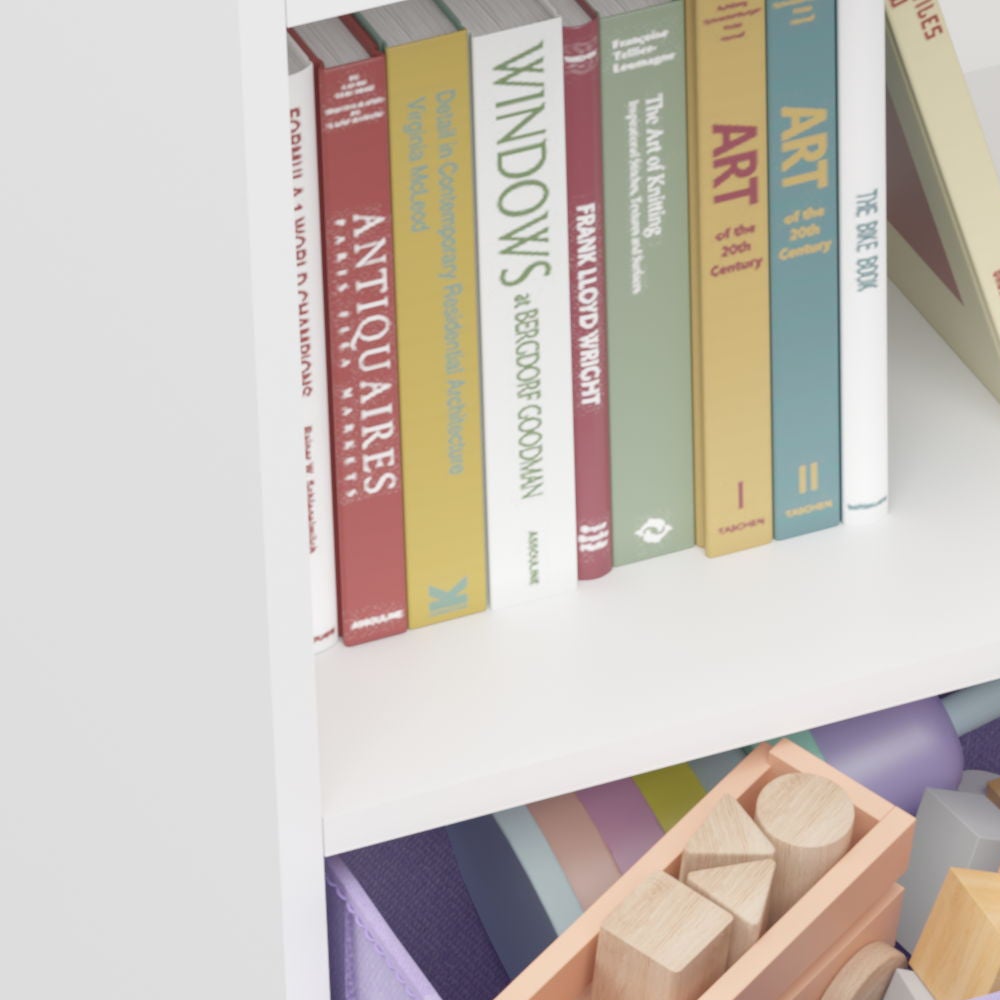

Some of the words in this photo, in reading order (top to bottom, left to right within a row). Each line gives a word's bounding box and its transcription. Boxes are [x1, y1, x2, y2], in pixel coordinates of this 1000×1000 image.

[912, 0, 943, 40] ILES
[434, 89, 456, 146] Detail
[644, 92, 664, 125] The
[404, 96, 427, 165] Virginia
[646, 128, 664, 154] Art
[780, 106, 828, 189] ART
[437, 147, 454, 159] in
[492, 40, 552, 287] WINDOWS
[645, 155, 665, 172] of
[711, 123, 758, 205] ART
[409, 166, 430, 233] McLeod
[642, 173, 666, 238] Knitting
[784, 209, 800, 224] of
[803, 207, 825, 220] the
[855, 188, 878, 218] THE
[436, 162, 460, 281] Contemporary
[576, 203, 597, 267] FRANK
[715, 227, 730, 241] of
[733, 224, 756, 237] the
[789, 225, 821, 240] 20th
[856, 220, 878, 252] BIKE
[710, 257, 763, 278] Century
[721, 243, 751, 258] 20th
[778, 240, 832, 261] Century
[856, 254, 878, 292] BOOK
[513, 293, 531, 309] at
[577, 267, 599, 330] LLOYD
[443, 282, 464, 374] Residential
[352, 213, 398, 494] ANTIQUAIRES
[514, 307, 541, 401] BERGDORF
[578, 329, 602, 406] WRIGHT
[446, 378, 467, 476] Architecture
[517, 404, 544, 500] GOODMAN
[718, 518, 765, 535] TASCHEN
[428, 576, 468, 613] K
